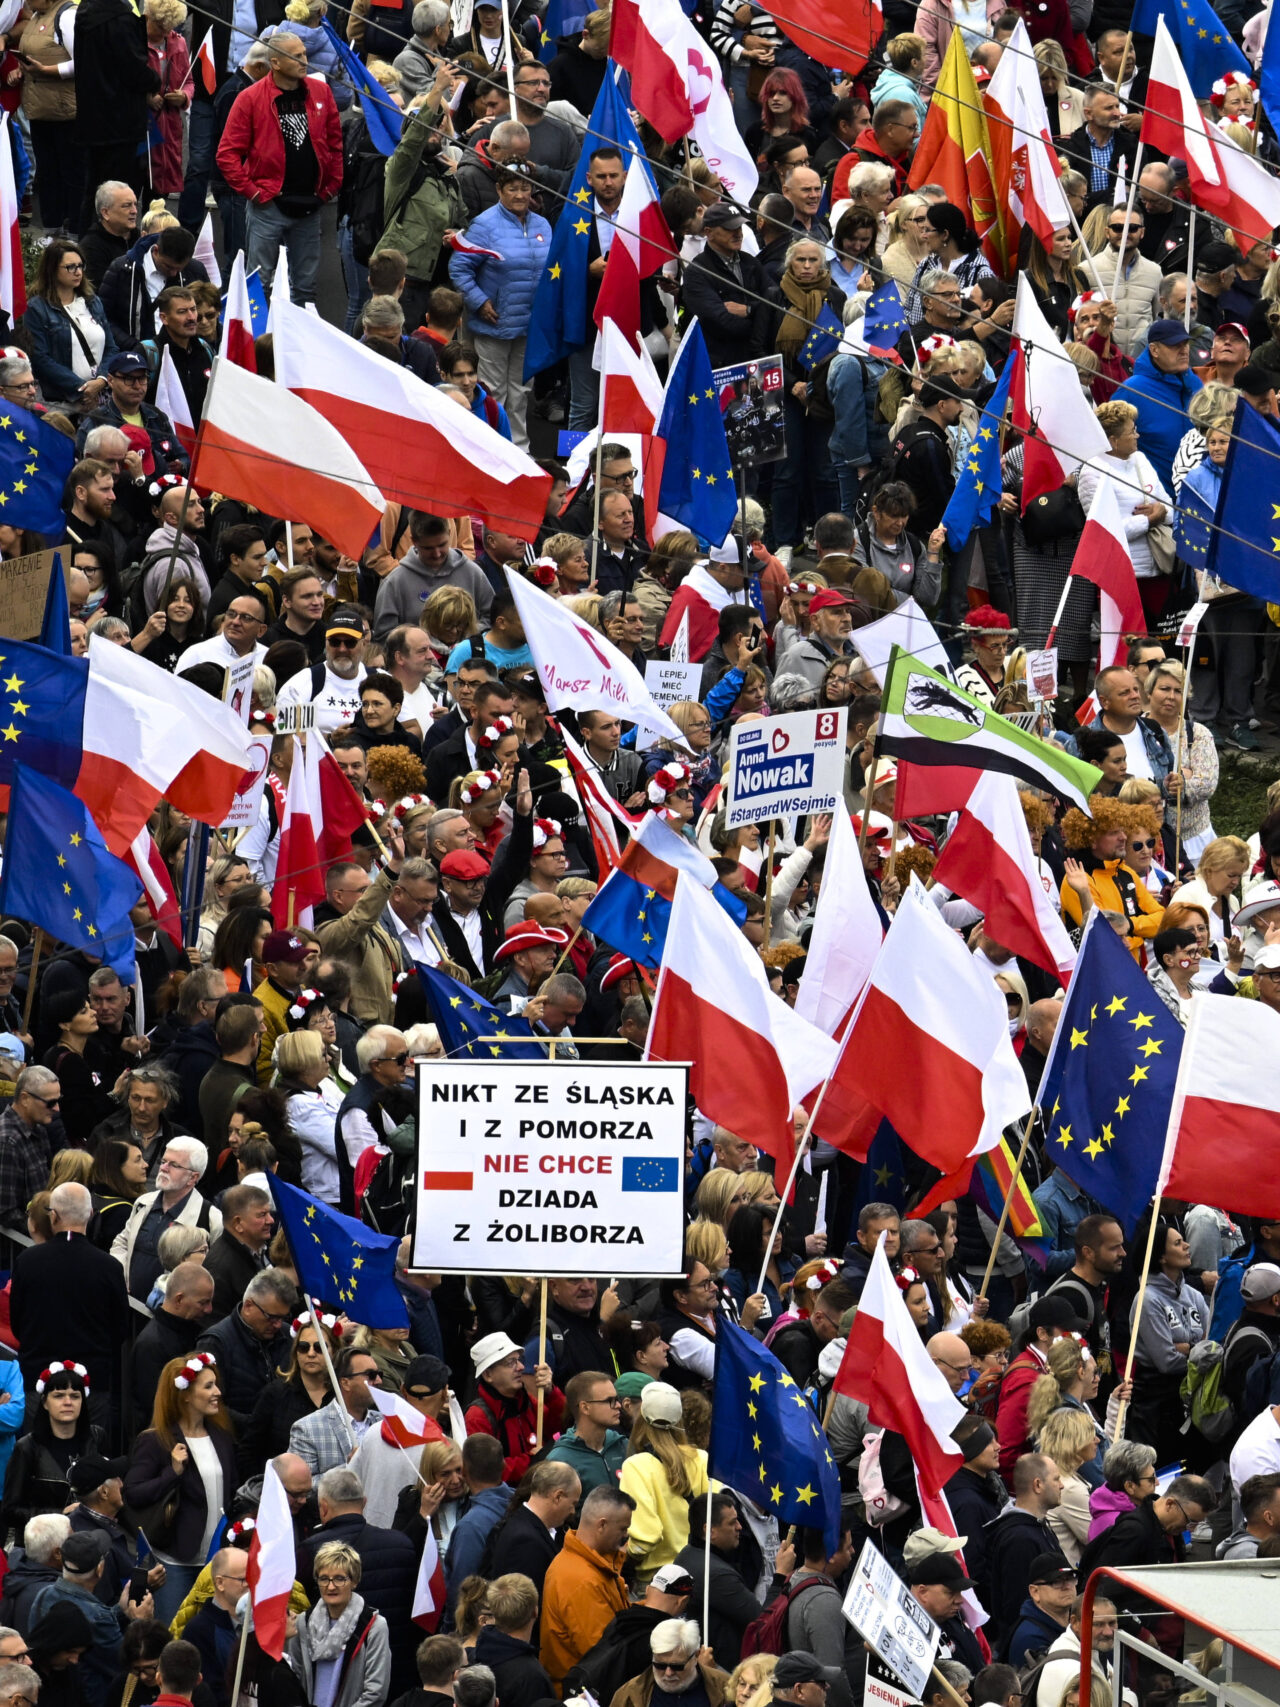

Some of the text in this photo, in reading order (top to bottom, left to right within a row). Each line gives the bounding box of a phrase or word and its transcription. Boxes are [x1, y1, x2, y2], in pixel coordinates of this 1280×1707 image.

[765, 371, 780, 387] 15
[660, 670, 687, 679] LEPIEJ
[662, 681, 682, 690] MIEĆ
[820, 714, 834, 736] 8
[814, 739, 837, 749] pozycja
[739, 752, 765, 767] Anna
[737, 759, 809, 795] Nowak
[730, 794, 836, 824] #StargardWSejmie
[432, 1081, 674, 1109] NIKT ZE ŚLĄSKA
[460, 1119, 653, 1139] I Z POMORZA
[484, 1154, 613, 1174] NIE CHCE
[499, 1189, 598, 1208] DZIADA
[453, 1220, 645, 1244] Z ŻOLIBORZA
